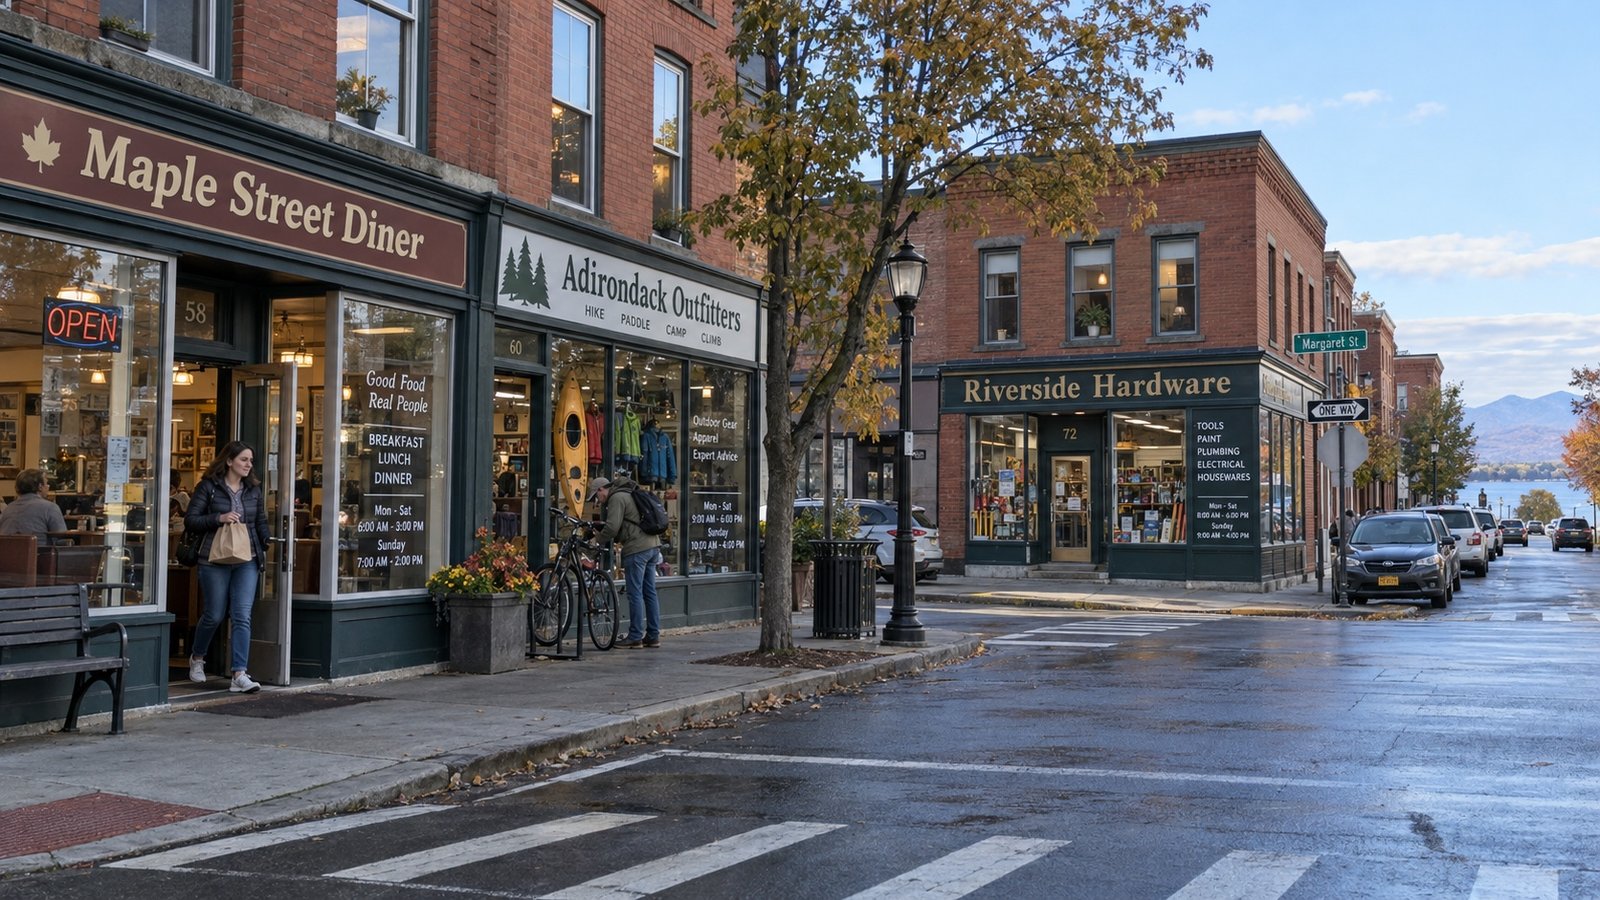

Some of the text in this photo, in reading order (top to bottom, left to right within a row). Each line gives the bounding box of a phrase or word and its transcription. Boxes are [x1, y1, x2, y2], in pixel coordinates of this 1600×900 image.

[80, 127, 424, 259] Maple Street Diner
[562, 254, 741, 332] Adirondack Outfitters
[185, 301, 206, 324] 58
[585, 304, 604, 320] HIKE
[48, 308, 117, 342] OPEN
[621, 314, 650, 331] PADDLE
[666, 324, 686, 338] CAMP
[701, 333, 722, 346] CLIMB
[1302, 336, 1358, 350] Margaret St
[510, 340, 522, 356] 60
[366, 370, 426, 392] Good Food
[964, 375, 1080, 402] Riverside
[1094, 372, 1230, 398] Hardware
[369, 392, 428, 416] Real People
[1320, 404, 1358, 416] ONE WAY
[693, 415, 738, 429] Outdoor Gear
[693, 432, 718, 445] Apparel
[1063, 428, 1077, 440] 72
[1197, 435, 1221, 443] PAINT
[369, 434, 424, 448] BREAKFAST
[693, 449, 738, 462] Expert Advice
[1198, 447, 1240, 455] PLUMBING
[378, 452, 410, 465] LUNCH
[1198, 460, 1245, 468] ELECTRICAL
[374, 472, 412, 484] DINNER
[1198, 473, 1250, 481] HOUSEWARES
[374, 505, 392, 516] Mon
[400, 505, 412, 516] Sat
[704, 501, 717, 510] Mon
[722, 502, 732, 510] Sat
[706, 514, 715, 523] AM
[734, 514, 743, 523] PM
[358, 522, 374, 532] 6:00
[376, 522, 388, 532] AM
[396, 521, 411, 531] 3:00
[413, 521, 424, 531] PM
[1212, 522, 1233, 531] Sunday
[708, 528, 728, 539] Sunday
[378, 539, 406, 553] Sunday
[708, 541, 717, 550] AM
[736, 540, 744, 548] PM
[357, 557, 374, 568] 7:00
[375, 556, 388, 566] AM
[395, 556, 410, 566] 2:00
[412, 555, 423, 565] PM
